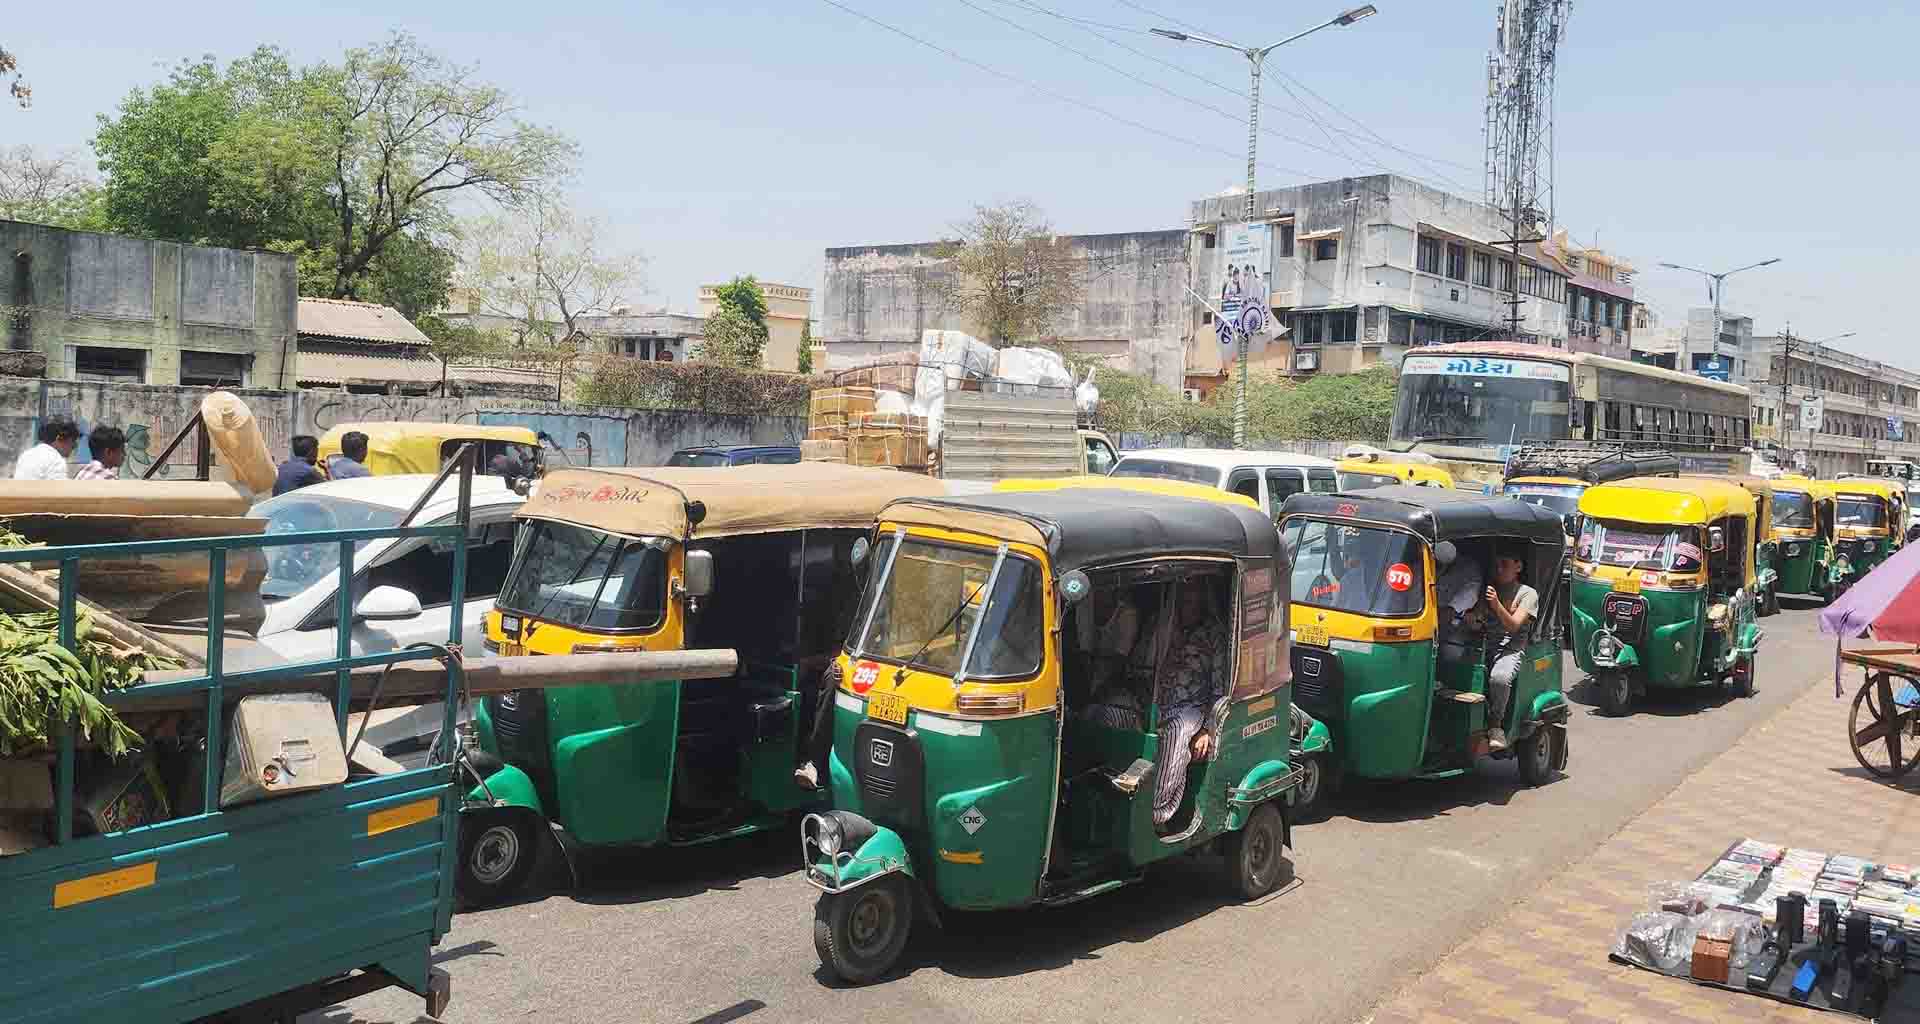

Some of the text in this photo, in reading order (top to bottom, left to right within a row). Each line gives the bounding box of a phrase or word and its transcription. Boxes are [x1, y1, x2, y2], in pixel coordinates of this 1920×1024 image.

[1446, 358, 1513, 375] મોટેરા
[1388, 570, 1411, 586] 579
[1631, 603, 1642, 615] P
[853, 667, 877, 686] 295
[962, 816, 981, 825] CNG
